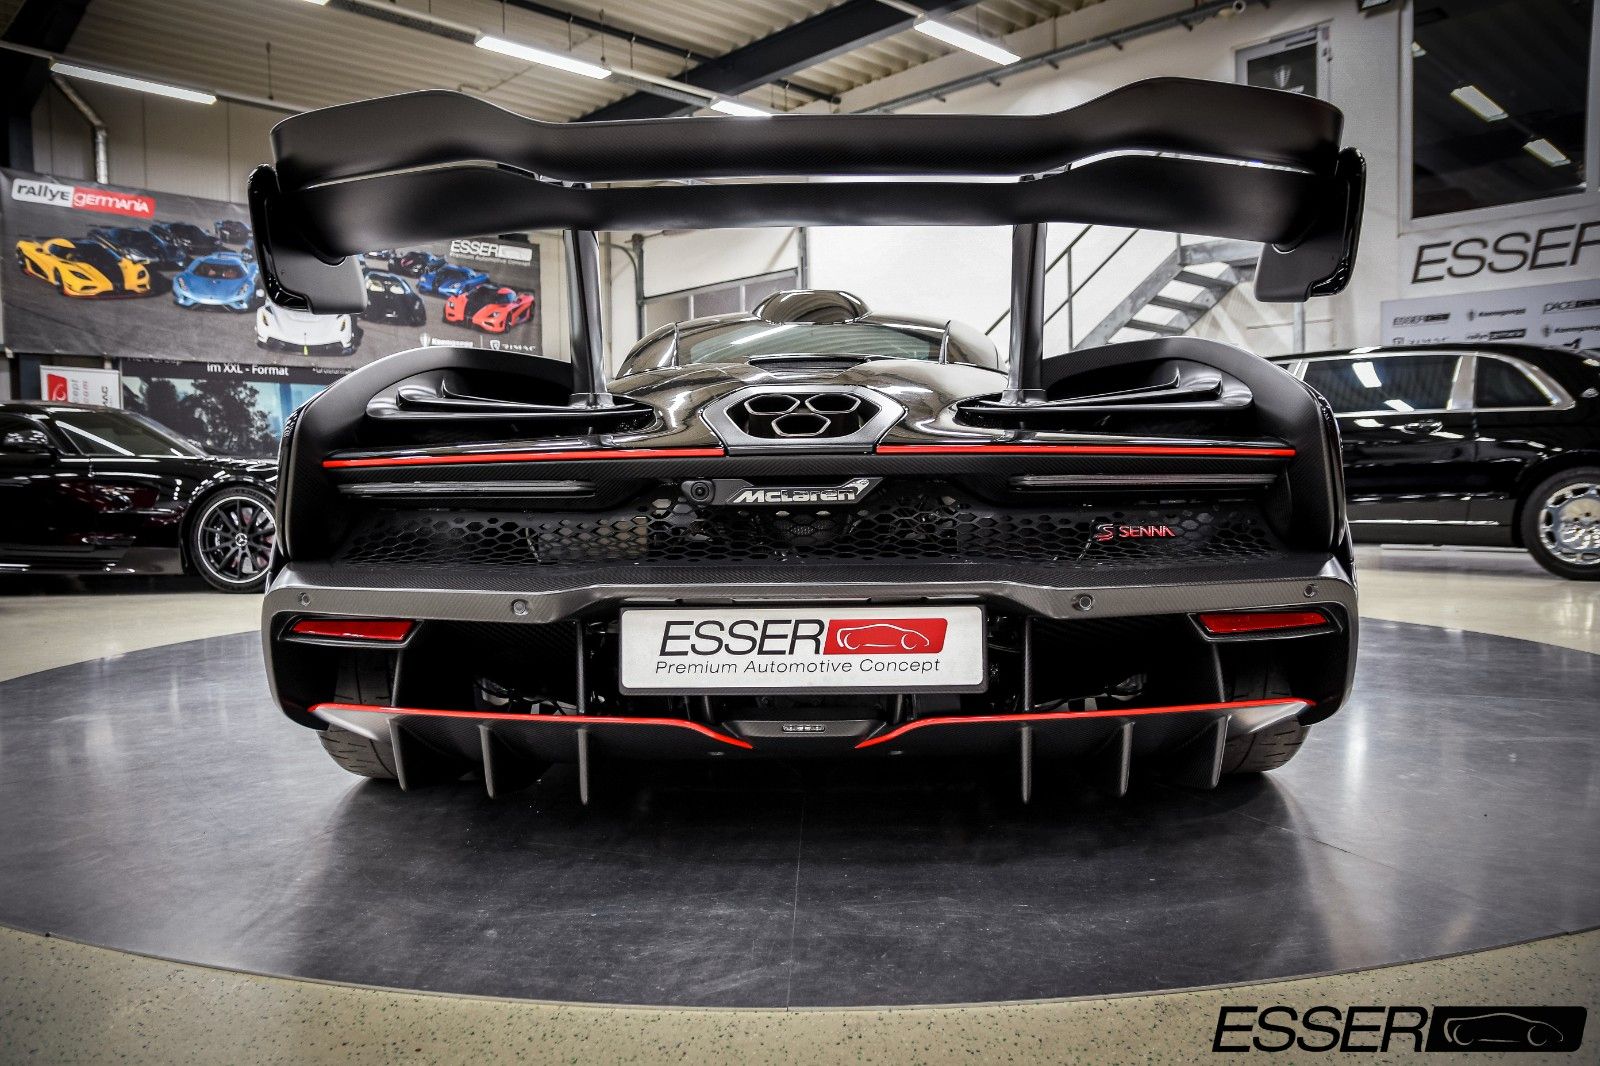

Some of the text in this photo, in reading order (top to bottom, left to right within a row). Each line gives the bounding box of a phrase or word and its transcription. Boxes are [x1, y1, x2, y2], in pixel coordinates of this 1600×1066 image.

[450, 239, 498, 258] ESSER
[207, 363, 221, 373] im
[223, 362, 243, 374] XXL
[252, 364, 289, 376] Format
[733, 489, 855, 503] McLaren
[1119, 525, 1175, 538] SENNA
[659, 619, 825, 656] ESSER
[655, 658, 941, 674] Premium Automotive Concept
